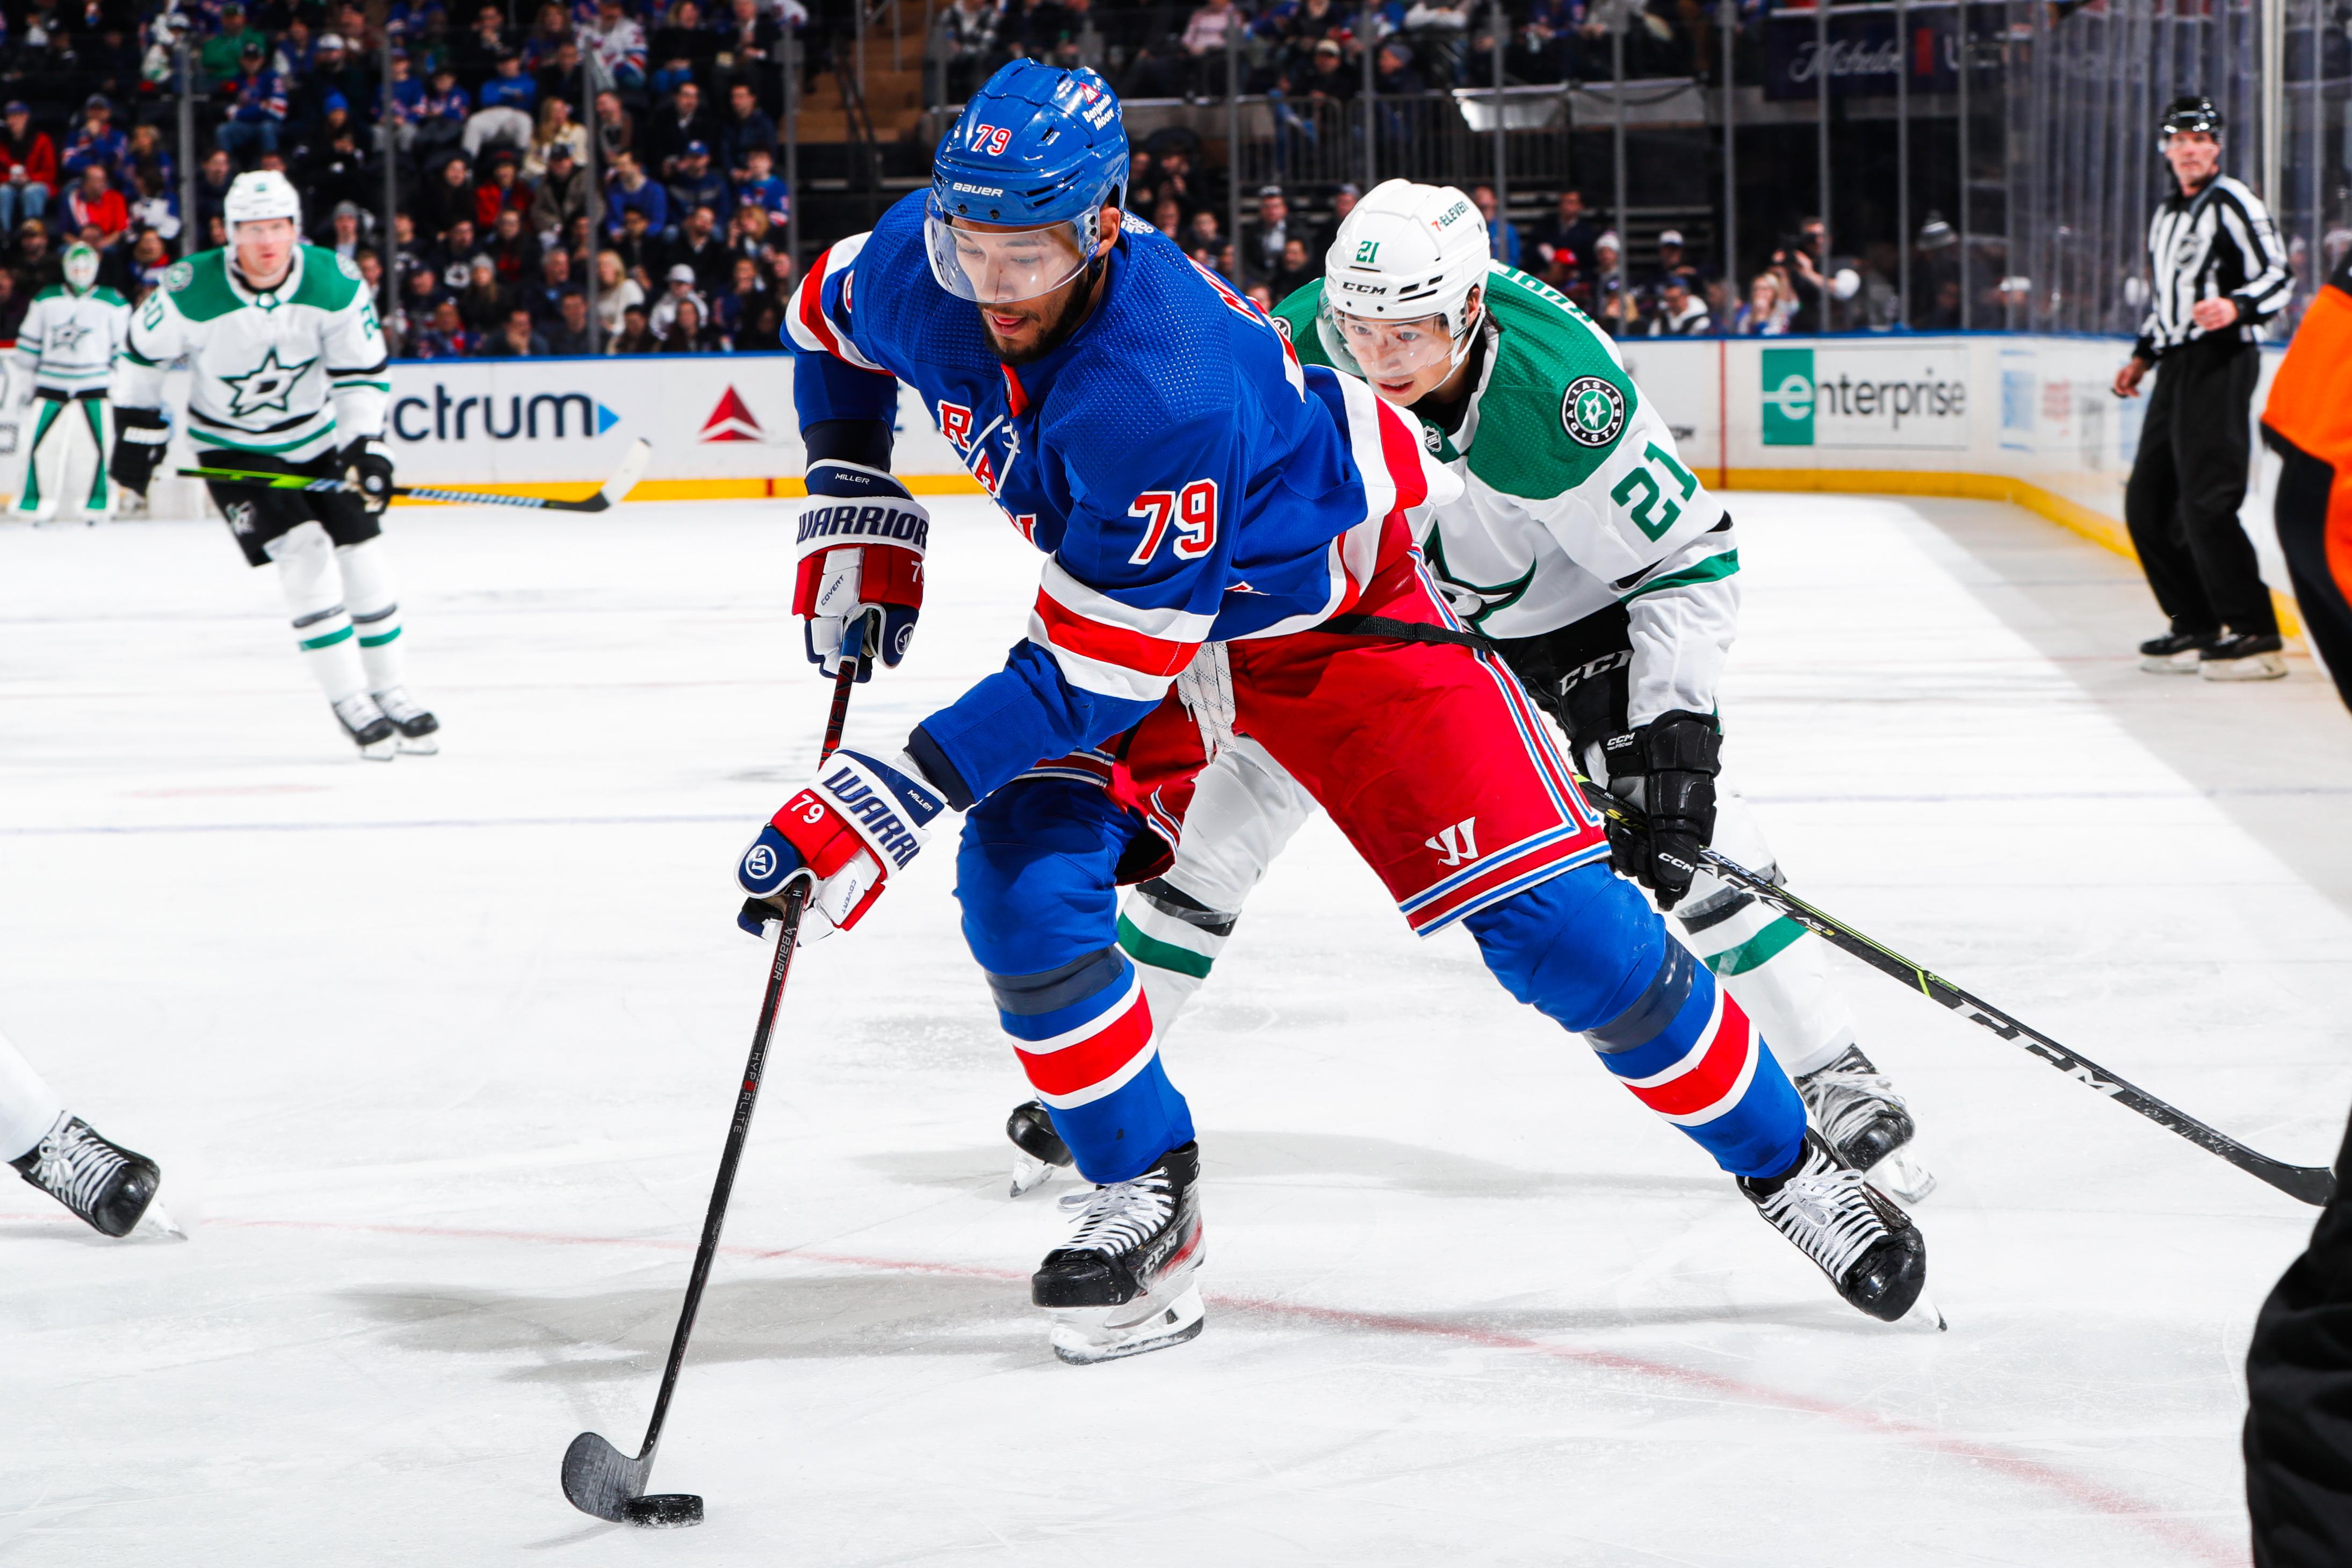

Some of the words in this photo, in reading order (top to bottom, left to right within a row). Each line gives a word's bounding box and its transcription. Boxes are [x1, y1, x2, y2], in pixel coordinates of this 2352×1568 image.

[1081, 93, 1112, 123] Benjamin
[1093, 107, 1115, 131] Moore
[970, 124, 1012, 156] 79
[1355, 240, 1380, 264] 21
[1342, 281, 1388, 295] CCM
[383, 384, 594, 442] ctrum
[1566, 381, 1600, 432] DALLAS
[1763, 367, 1965, 431] enterprise
[1591, 395, 1621, 442] STARS
[835, 473, 870, 485] MILLER
[1611, 441, 1697, 543] 21
[796, 506, 929, 550] WARRIOR
[1128, 478, 1218, 565] 79
[820, 574, 845, 606] COVERT
[1607, 732, 1636, 746] CCM
[790, 793, 825, 824] 79
[907, 790, 934, 812] MILLER
[1658, 852, 1695, 873] CCM
[841, 879, 857, 914] COVERT
[1953, 998, 2125, 1097] CCM
